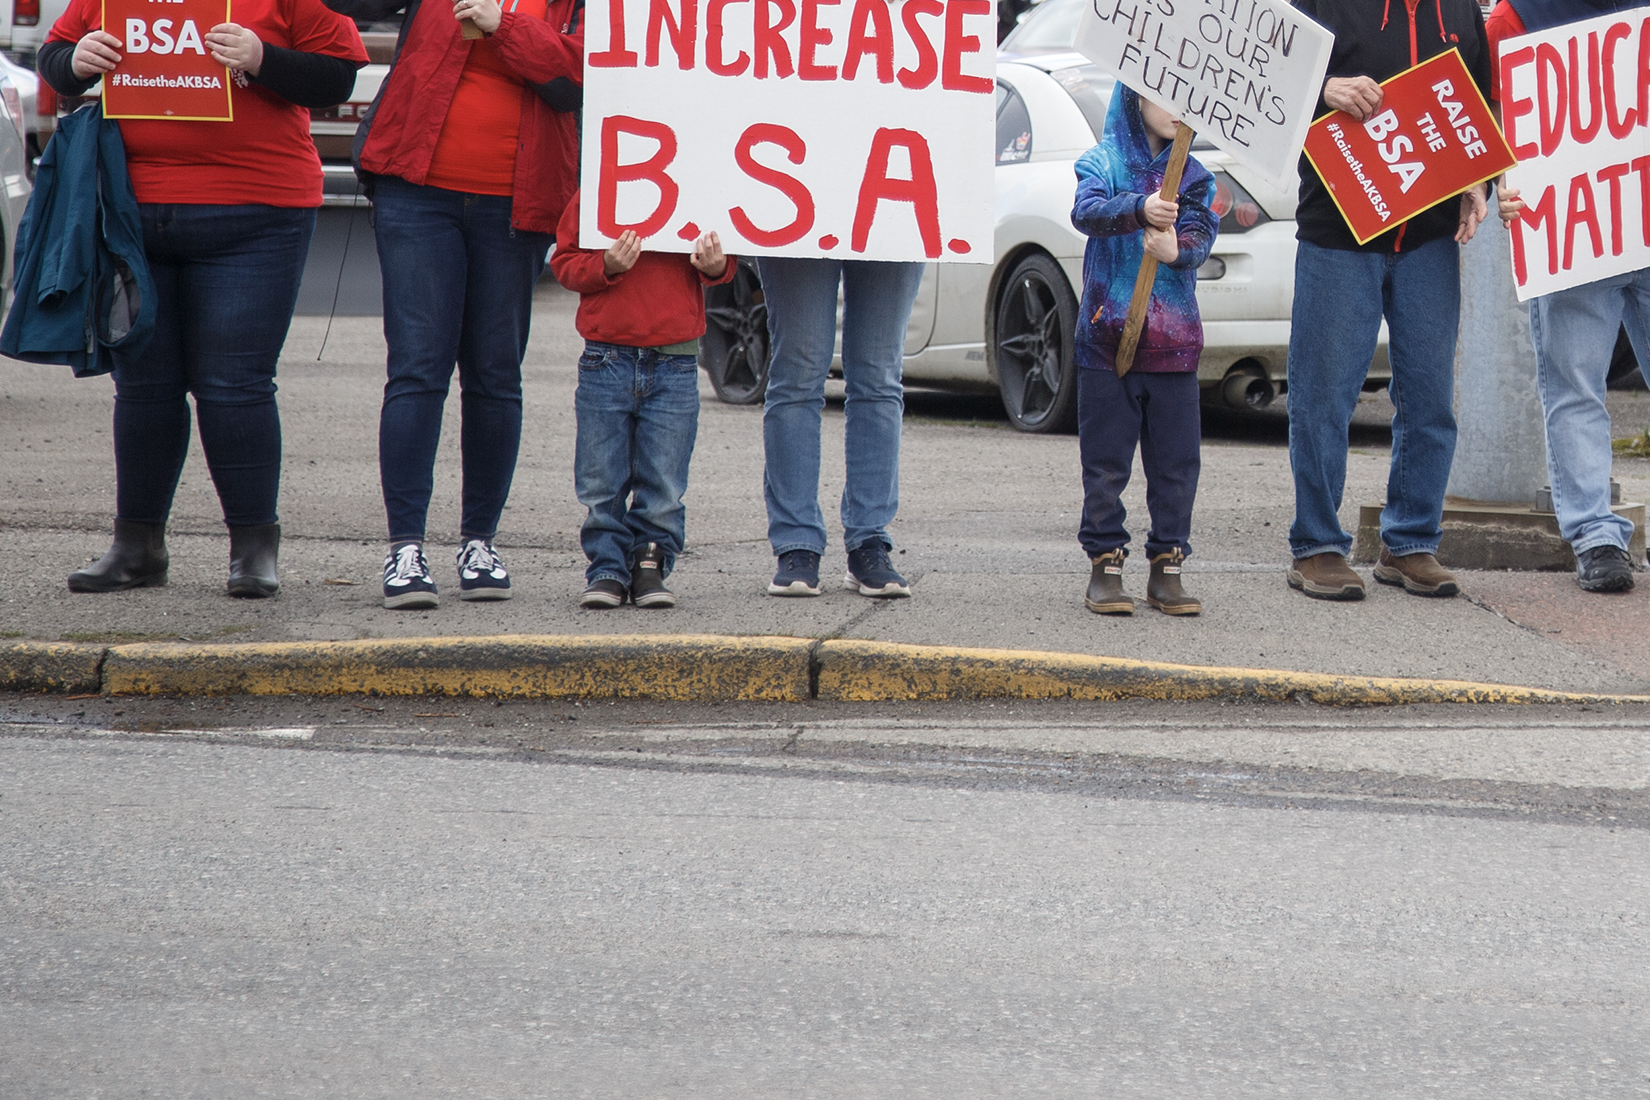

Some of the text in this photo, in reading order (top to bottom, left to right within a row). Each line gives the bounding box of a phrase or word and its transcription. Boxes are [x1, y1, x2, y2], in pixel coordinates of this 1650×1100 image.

[125, 18, 205, 55] BSA
[1199, 13, 1270, 78] OUR
[112, 74, 221, 90] #RaisetheAKBSA
[1118, 43, 1255, 147] FUTURE
[1431, 79, 1488, 160] RAISE
[1326, 123, 1391, 223] #RaisetheAKBSA
[1363, 108, 1426, 194] BSA
[1416, 112, 1447, 153] THE
[597, 114, 972, 259] B.S.A.
